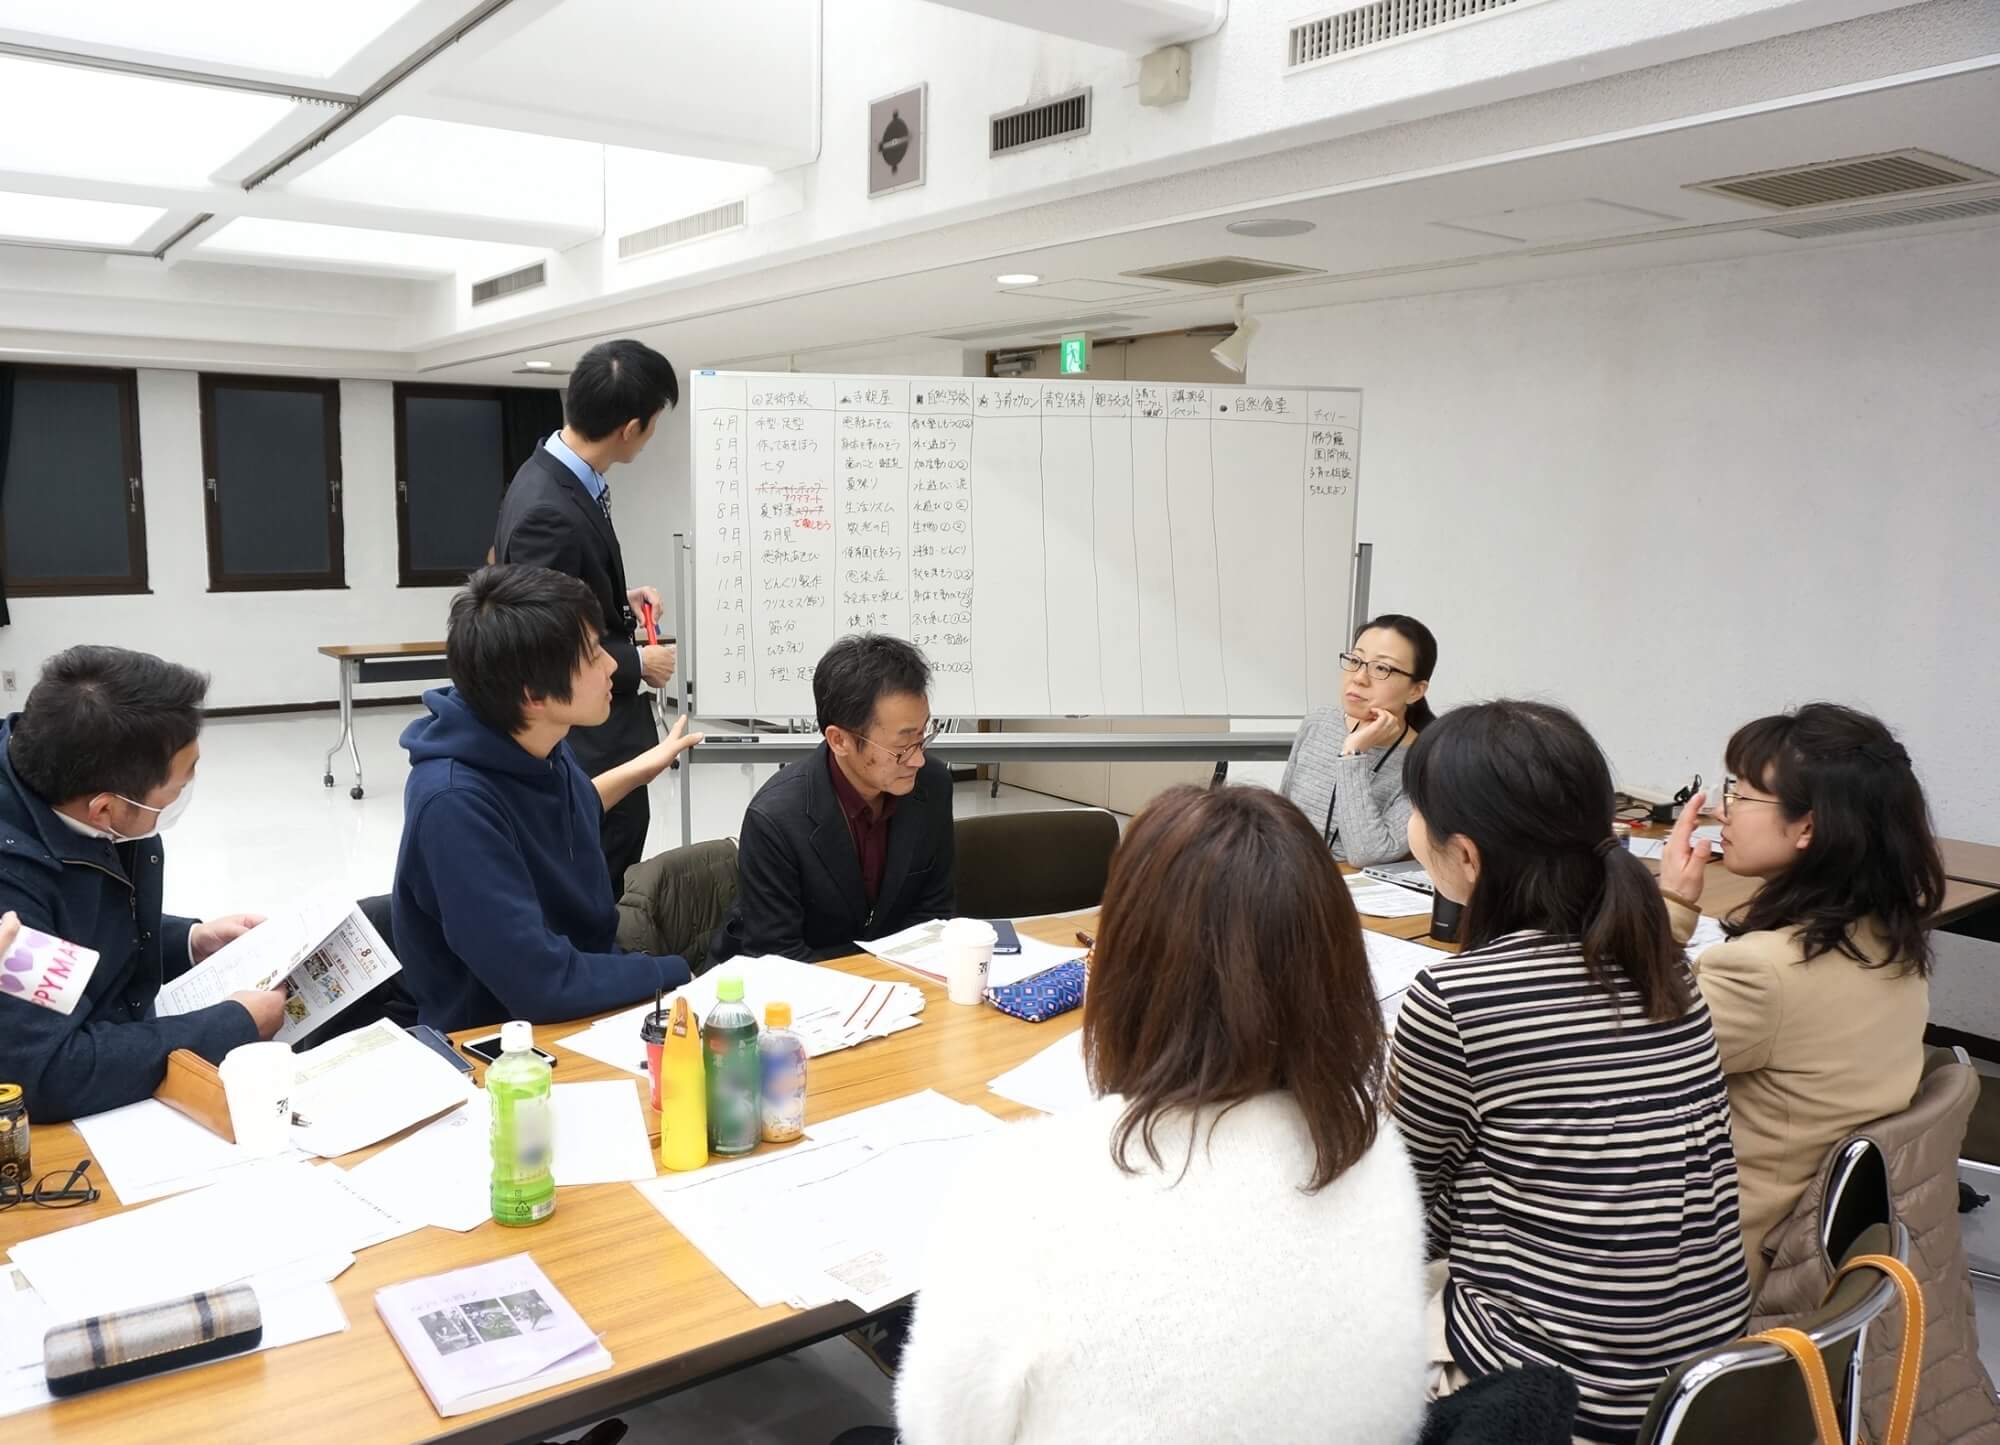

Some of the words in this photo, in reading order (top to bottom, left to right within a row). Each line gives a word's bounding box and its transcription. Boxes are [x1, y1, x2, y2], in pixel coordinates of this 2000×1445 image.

[1043, 390, 1086, 409] 青空保育
[712, 414, 739, 434] 4月
[713, 437, 738, 456] 5月
[715, 456, 738, 475] 6月
[761, 459, 786, 474] 七夕
[715, 480, 739, 499] 7月
[717, 502, 740, 520] 8月
[718, 527, 741, 545] 9月
[762, 526, 798, 543] お月見
[716, 550, 743, 570] 10月
[718, 575, 744, 593] 11月
[717, 598, 744, 614] 12月
[723, 622, 745, 641] 1月
[768, 619, 797, 636] 節分
[723, 644, 746, 662] 2月
[723, 670, 747, 687] 3月
